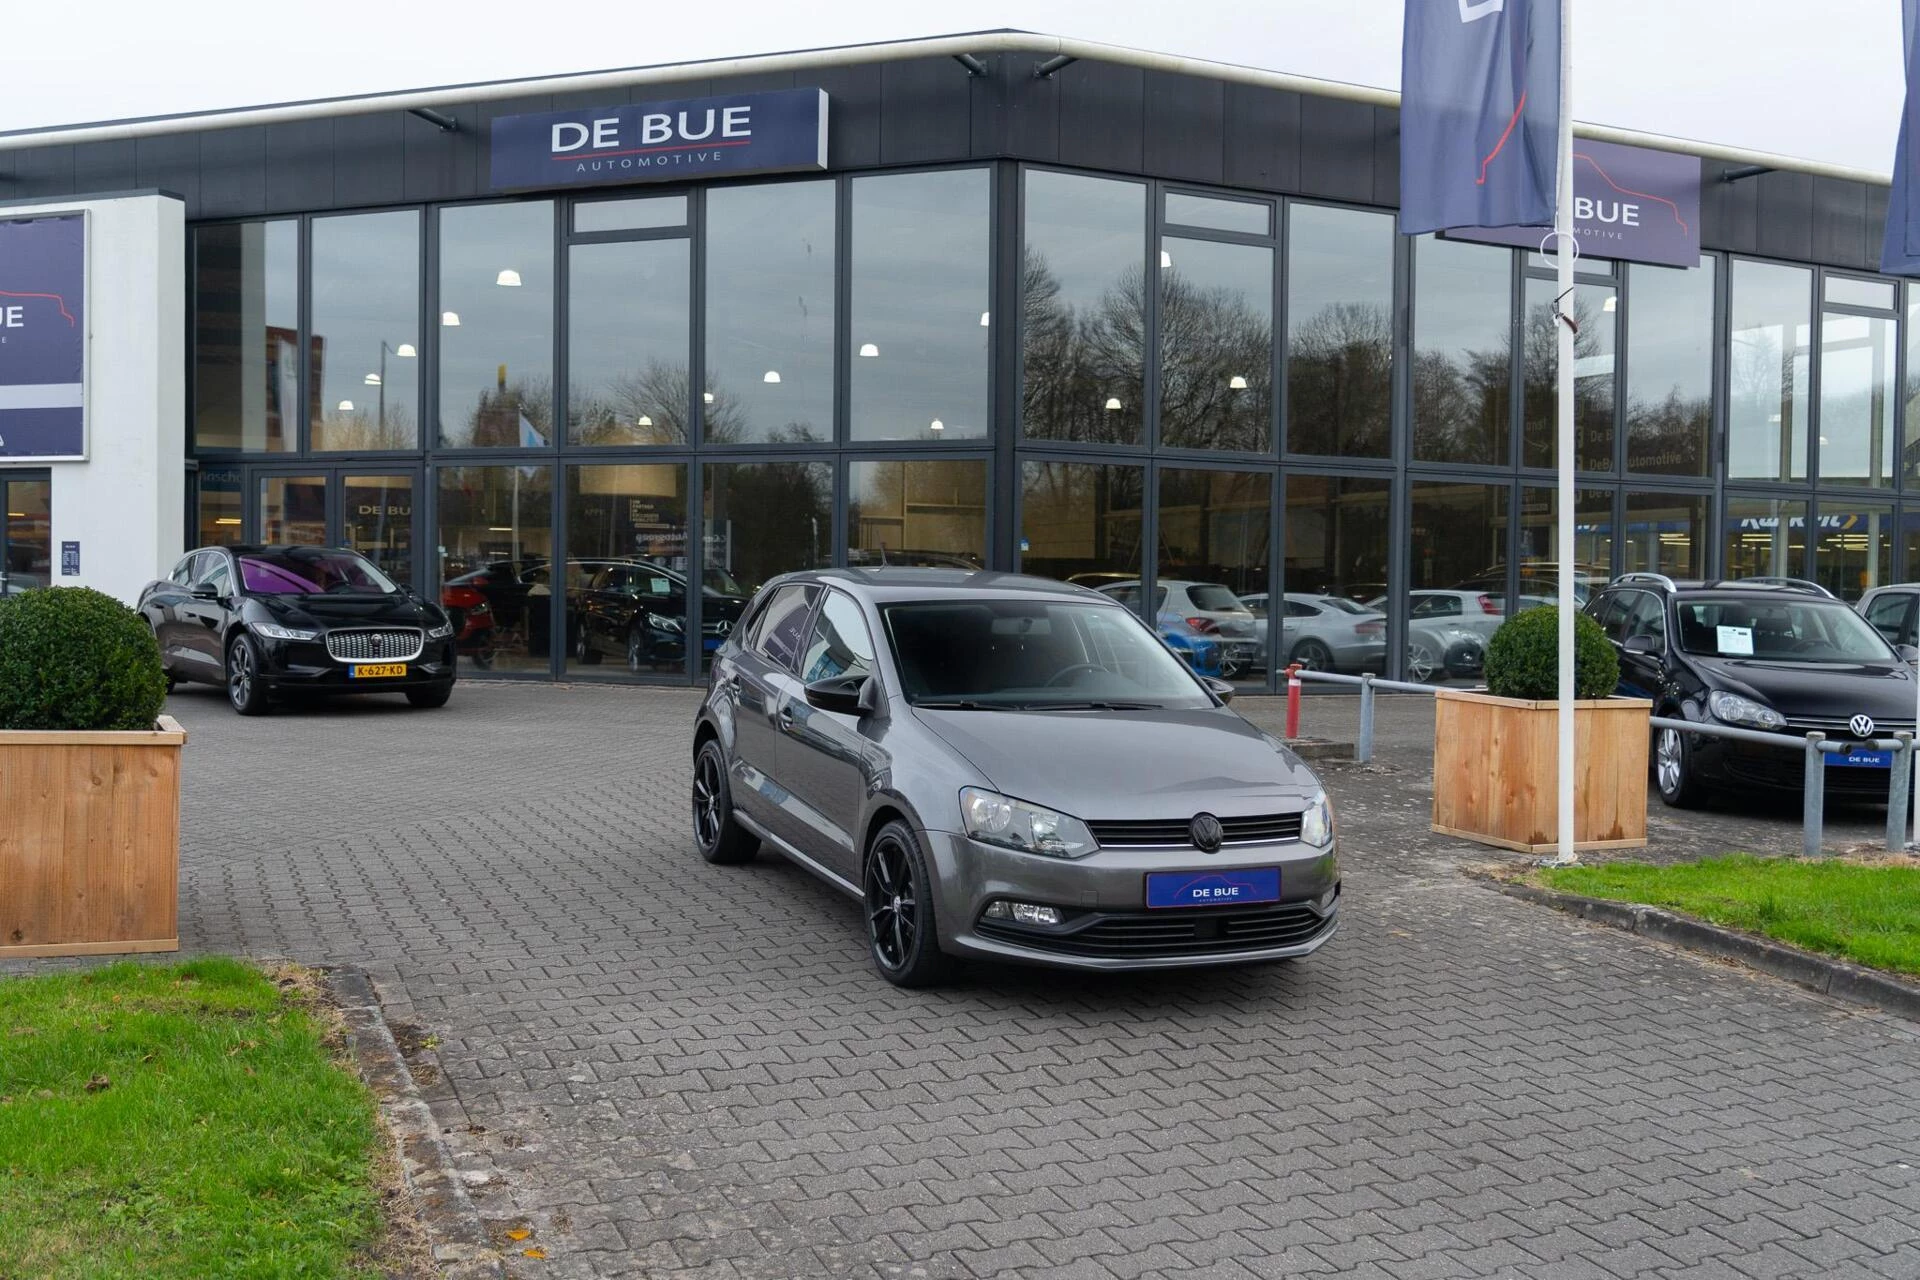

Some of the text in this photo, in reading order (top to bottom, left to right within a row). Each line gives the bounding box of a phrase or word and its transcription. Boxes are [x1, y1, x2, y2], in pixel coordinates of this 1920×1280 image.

[551, 106, 752, 152] DE BUE
[576, 151, 722, 172] AUTOMOTIVE
[1574, 197, 1640, 226] BUE
[358, 505, 411, 516] DE BU
[358, 665, 403, 676] K-627-KD
[1192, 887, 1239, 898] DE BUE
